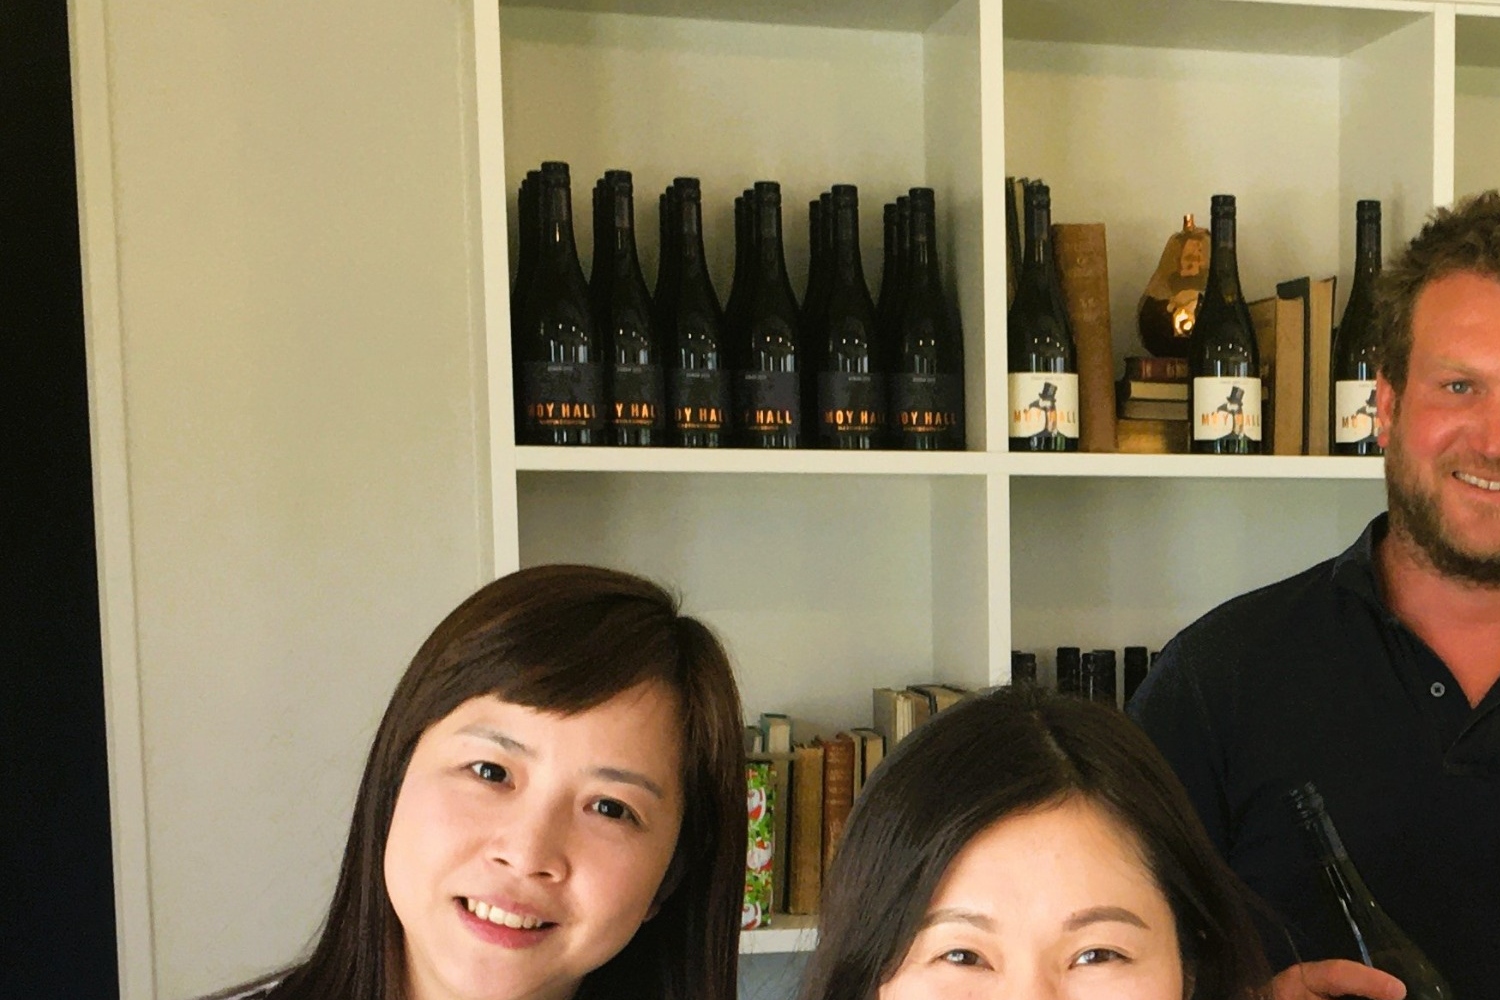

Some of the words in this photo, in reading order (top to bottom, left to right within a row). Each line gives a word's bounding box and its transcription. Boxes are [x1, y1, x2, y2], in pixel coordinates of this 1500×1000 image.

[631, 403, 656, 418] HAL
[699, 408, 724, 422] HAL
[756, 410, 792, 424] HALL
